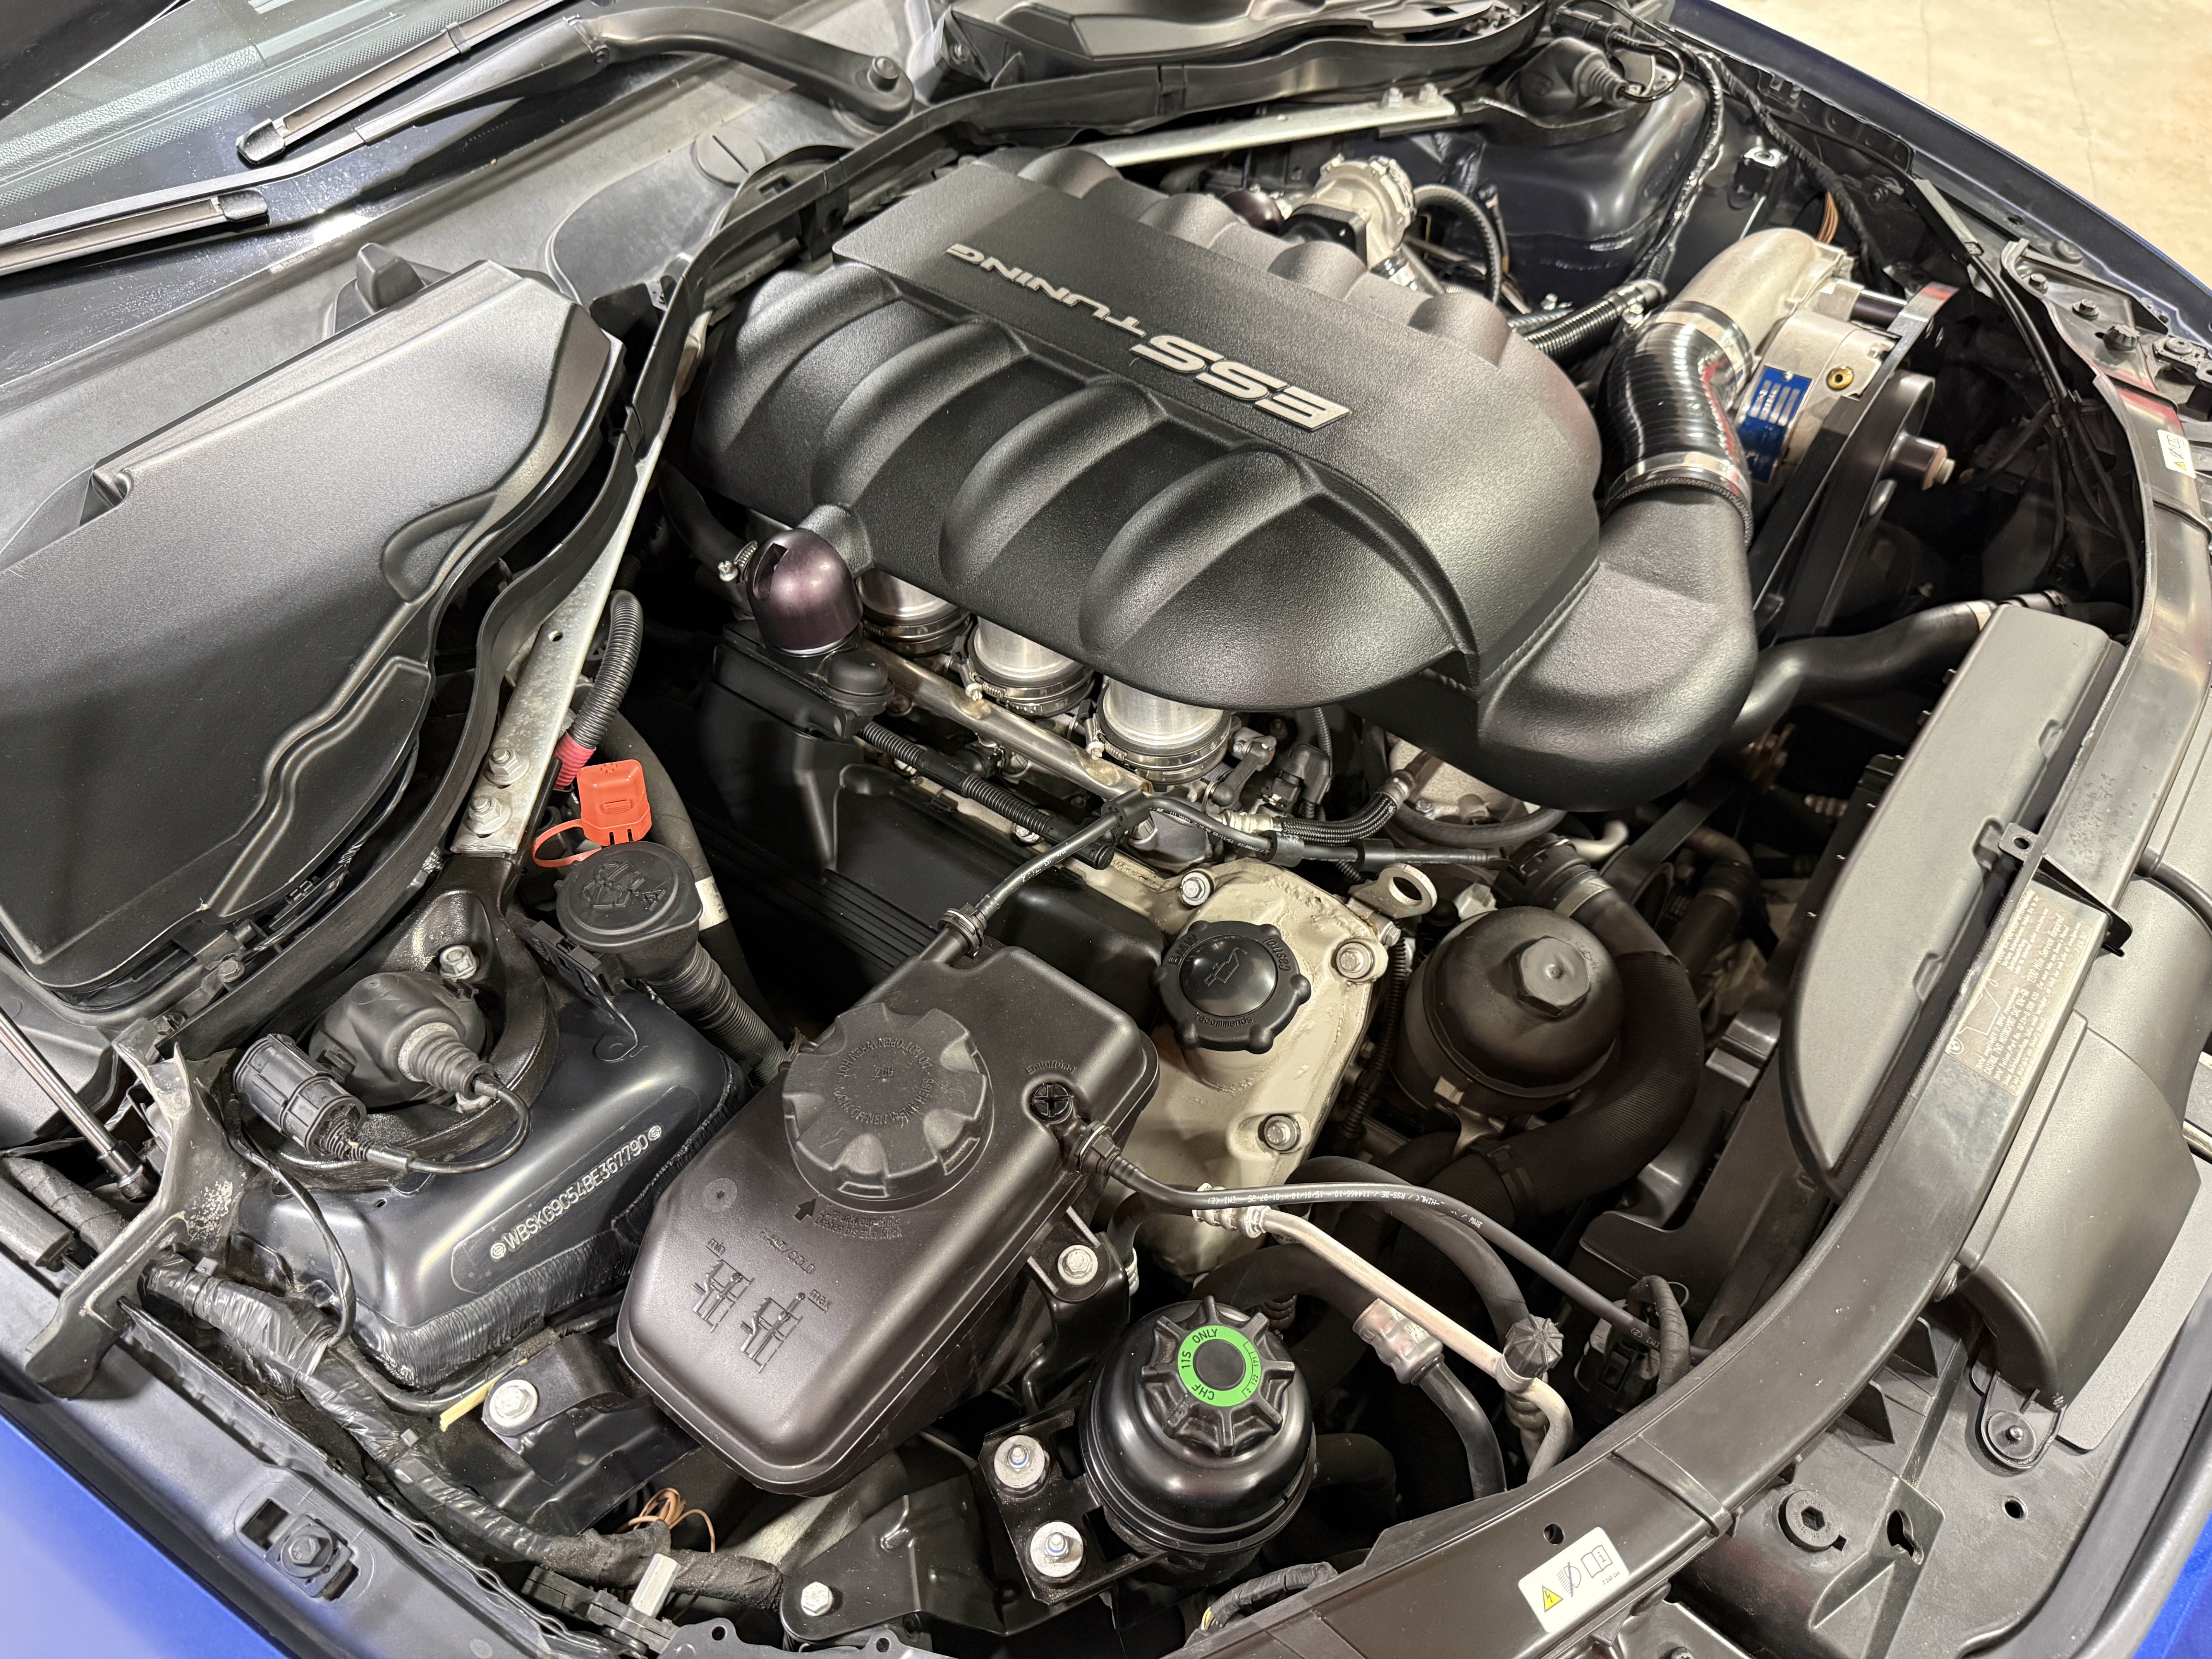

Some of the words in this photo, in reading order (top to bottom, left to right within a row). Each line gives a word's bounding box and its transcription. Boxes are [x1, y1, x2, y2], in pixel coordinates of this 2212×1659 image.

[946, 243, 1145, 337] TUNING
[1129, 334, 1350, 429] ESS
[2047, 912, 2067, 938] Required!
[1168, 934, 1199, 966] BMW
[1262, 938, 1290, 972] Castrol
[2038, 938, 2054, 957] Service
[2032, 955, 2044, 970] Mile
[2026, 969, 2039, 983] 1200
[2015, 987, 2029, 1006] 10W-60
[1195, 1012, 1253, 1027] recommends
[1996, 1013, 2006, 1026] BMW
[2010, 1005, 2021, 1017] SAE
[1998, 1016, 2016, 1044] MOTORSPORT
[1993, 1043, 2003, 1054] TWS
[1983, 1054, 1999, 1074] CASTROL
[915, 1078, 934, 1106] HEISS
[1381, 1190, 1406, 1200] RSS-DE
[1468, 1216, 1483, 1228] BMW
[707, 1238, 727, 1256] min
[809, 1288, 833, 1310] max
[1192, 1328, 1218, 1345] ONLY
[1630, 1327, 1643, 1337] (2)
[1181, 1350, 1192, 1369] 11S
[1251, 1374, 1259, 1386] 122
[1191, 1383, 1215, 1401] CHF
